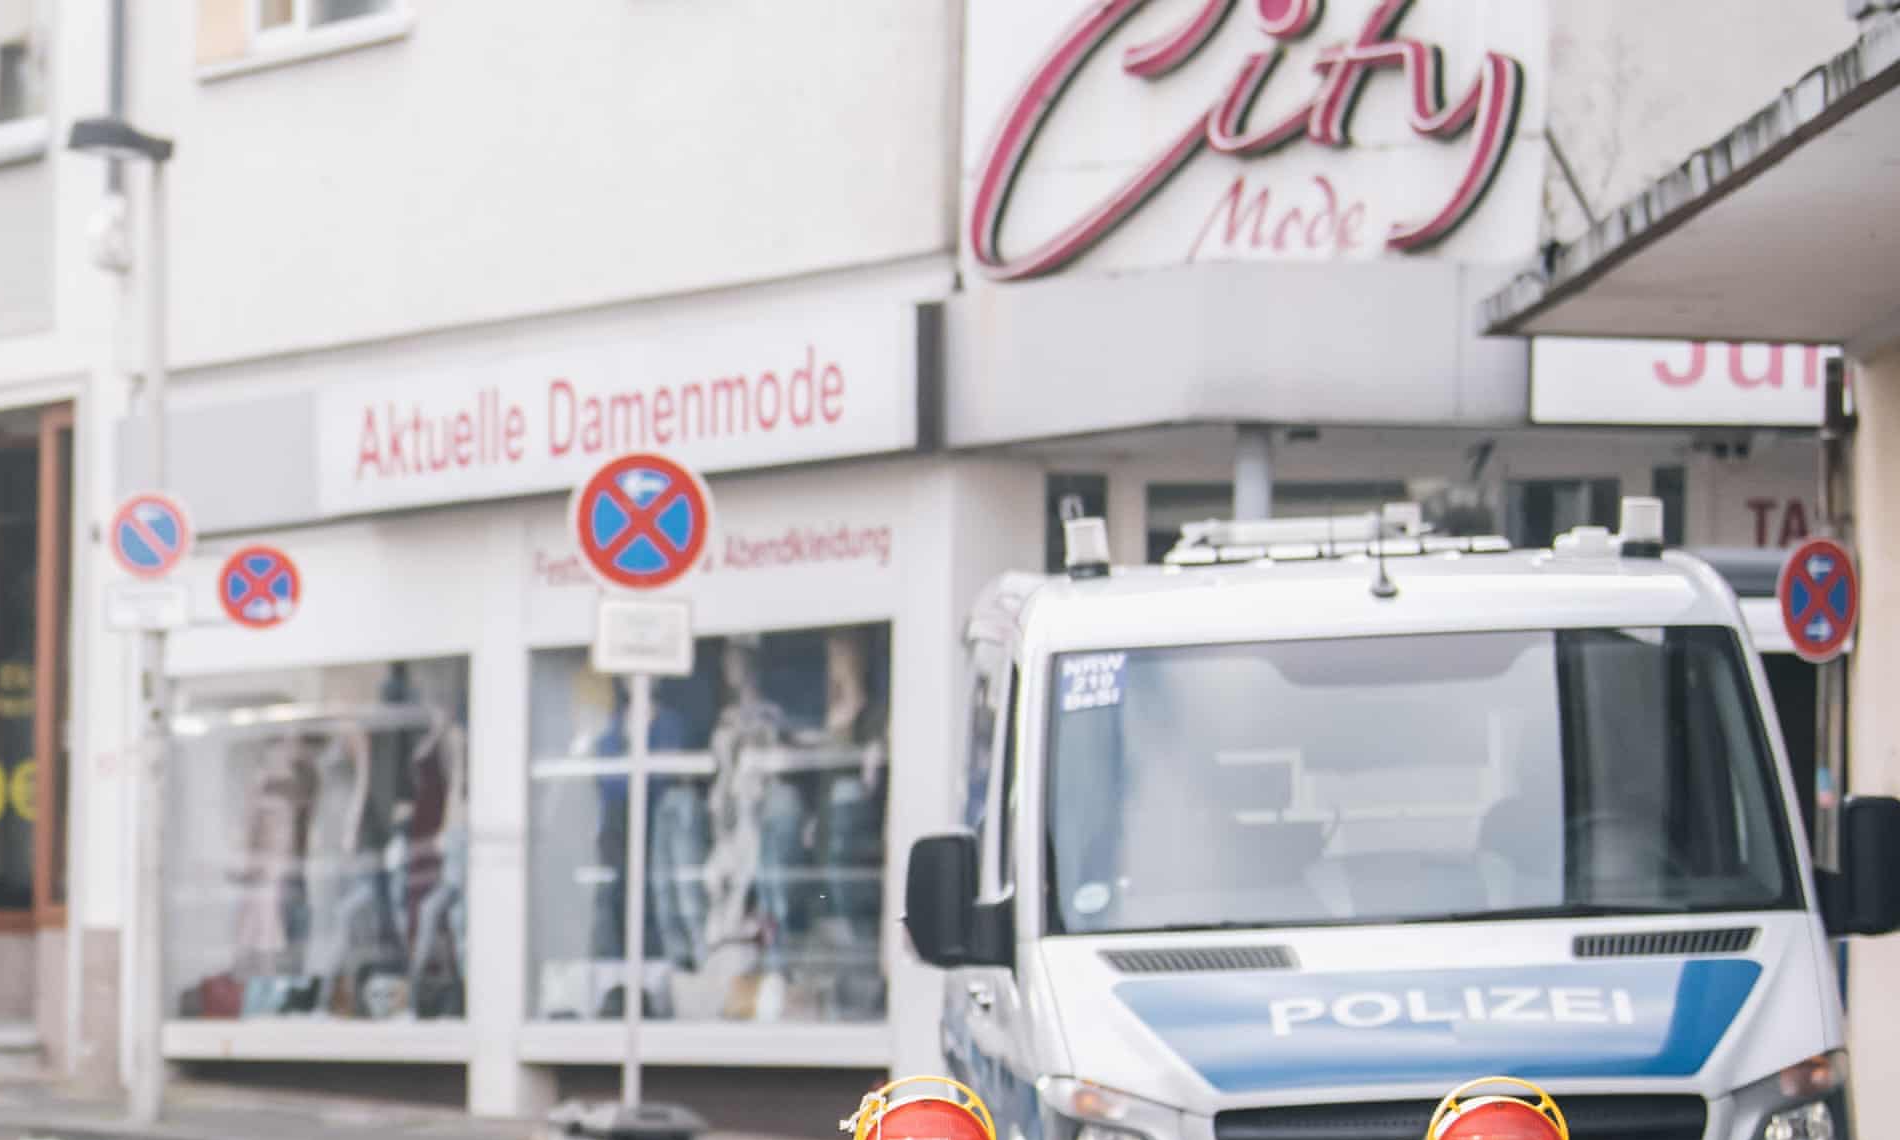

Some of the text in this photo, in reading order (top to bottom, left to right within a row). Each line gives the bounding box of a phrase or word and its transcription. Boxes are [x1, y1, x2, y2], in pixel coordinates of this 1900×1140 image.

[971, 0, 1524, 281] City
[1189, 175, 1366, 265] Mode
[356, 345, 846, 481] Aktuelle Damenmode
[722, 524, 892, 567] Abendkleidung
[1269, 985, 1635, 1037] POLIZEI
